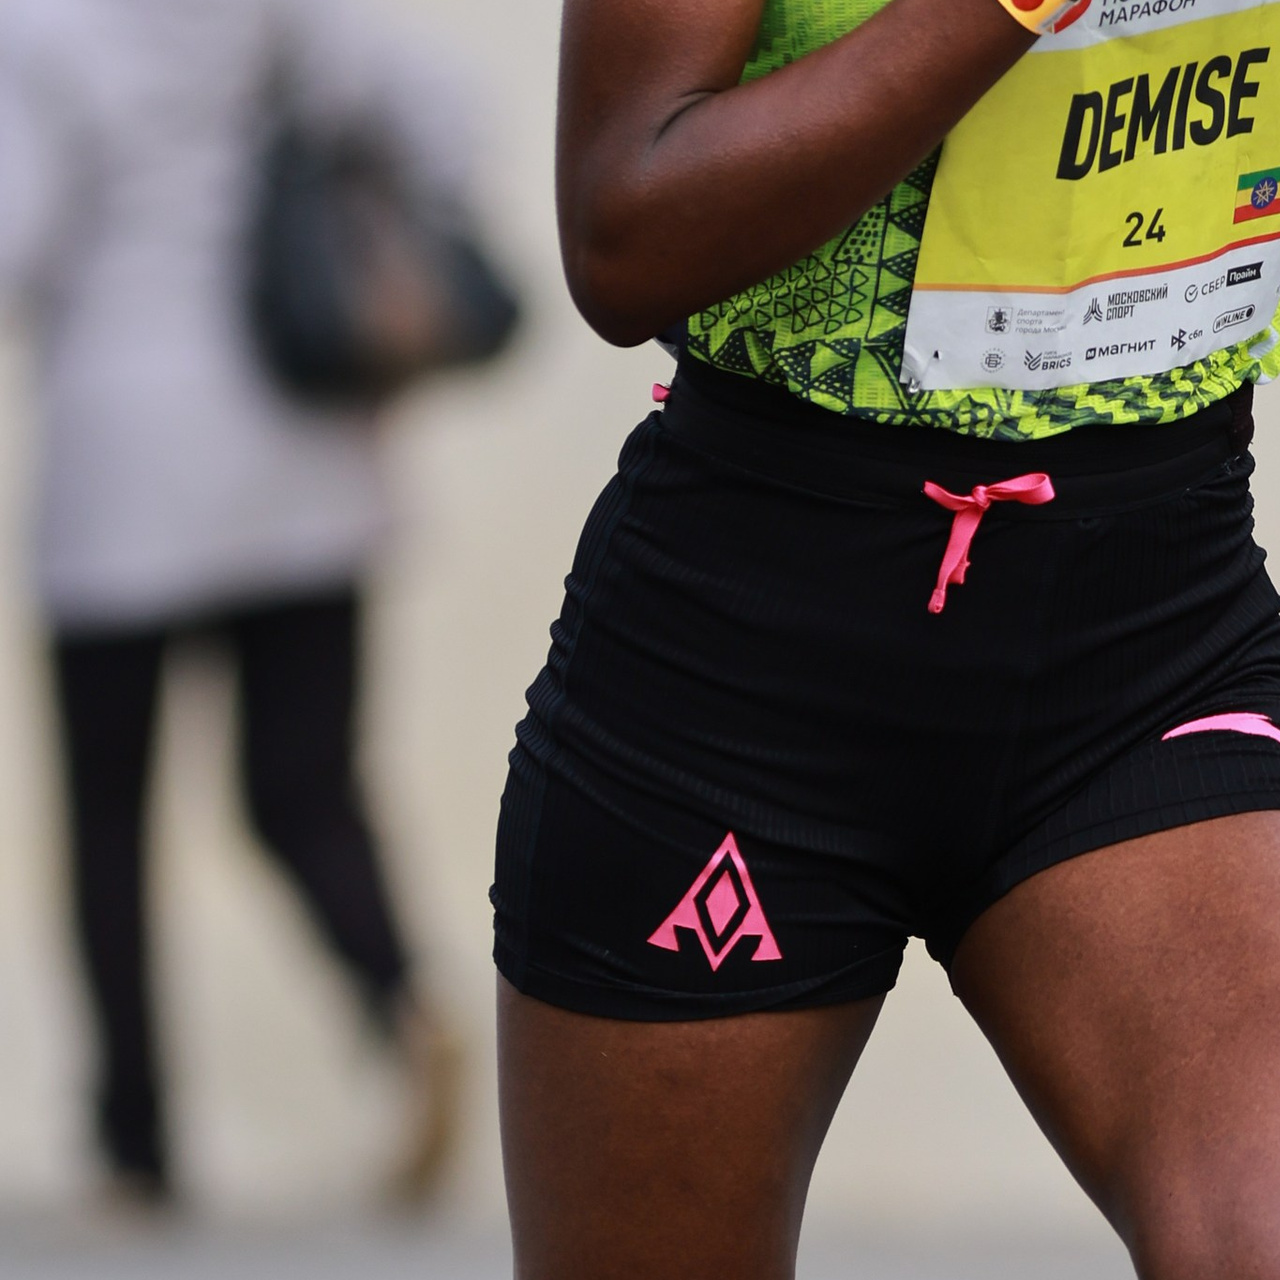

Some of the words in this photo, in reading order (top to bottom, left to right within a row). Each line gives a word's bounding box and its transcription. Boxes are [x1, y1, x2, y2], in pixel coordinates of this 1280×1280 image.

[1056, 47, 1270, 180] DEMISE
[1122, 208, 1166, 247] 24
[1201, 275, 1225, 295] СБЕР
[1229, 267, 1257, 282] Прайм
[1107, 283, 1168, 307] МОСКОВСКИЙ
[1106, 304, 1135, 321] СПОРТ
[1215, 310, 1246, 330] WINLINE
[1188, 329, 1203, 341] сбп
[1098, 339, 1156, 357] магнит
[1041, 357, 1072, 371] BRICS
